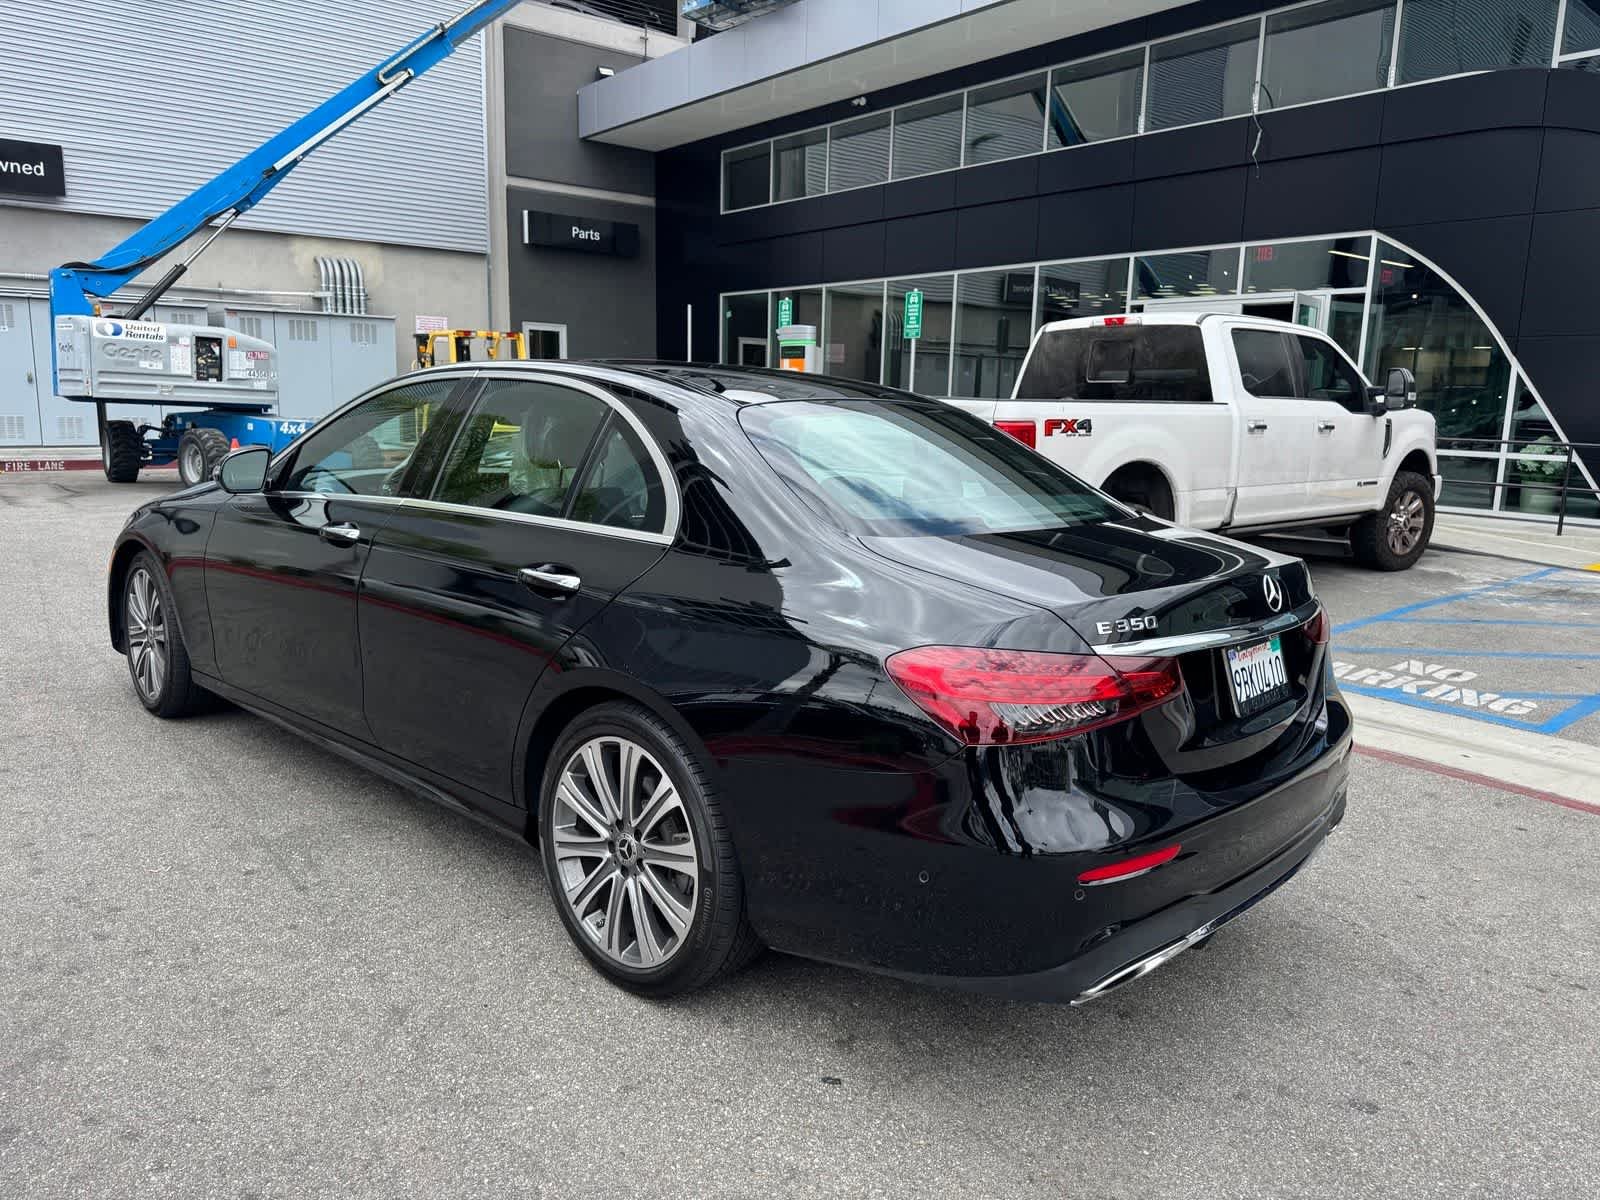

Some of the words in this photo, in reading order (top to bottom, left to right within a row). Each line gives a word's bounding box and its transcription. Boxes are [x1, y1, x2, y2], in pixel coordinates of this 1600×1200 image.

[571, 225, 601, 241] Parts
[124, 323, 161, 333] United
[124, 331, 164, 341] Rentals
[280, 421, 306, 435] 4x4
[1044, 418, 1093, 437] FX4
[4, 461, 32, 472] FIRE
[37, 460, 65, 471] LANE
[1095, 621, 1113, 635] E
[1115, 615, 1159, 633] 350
[1387, 659, 1478, 682] NO
[1234, 655, 1285, 704] 9BKU410
